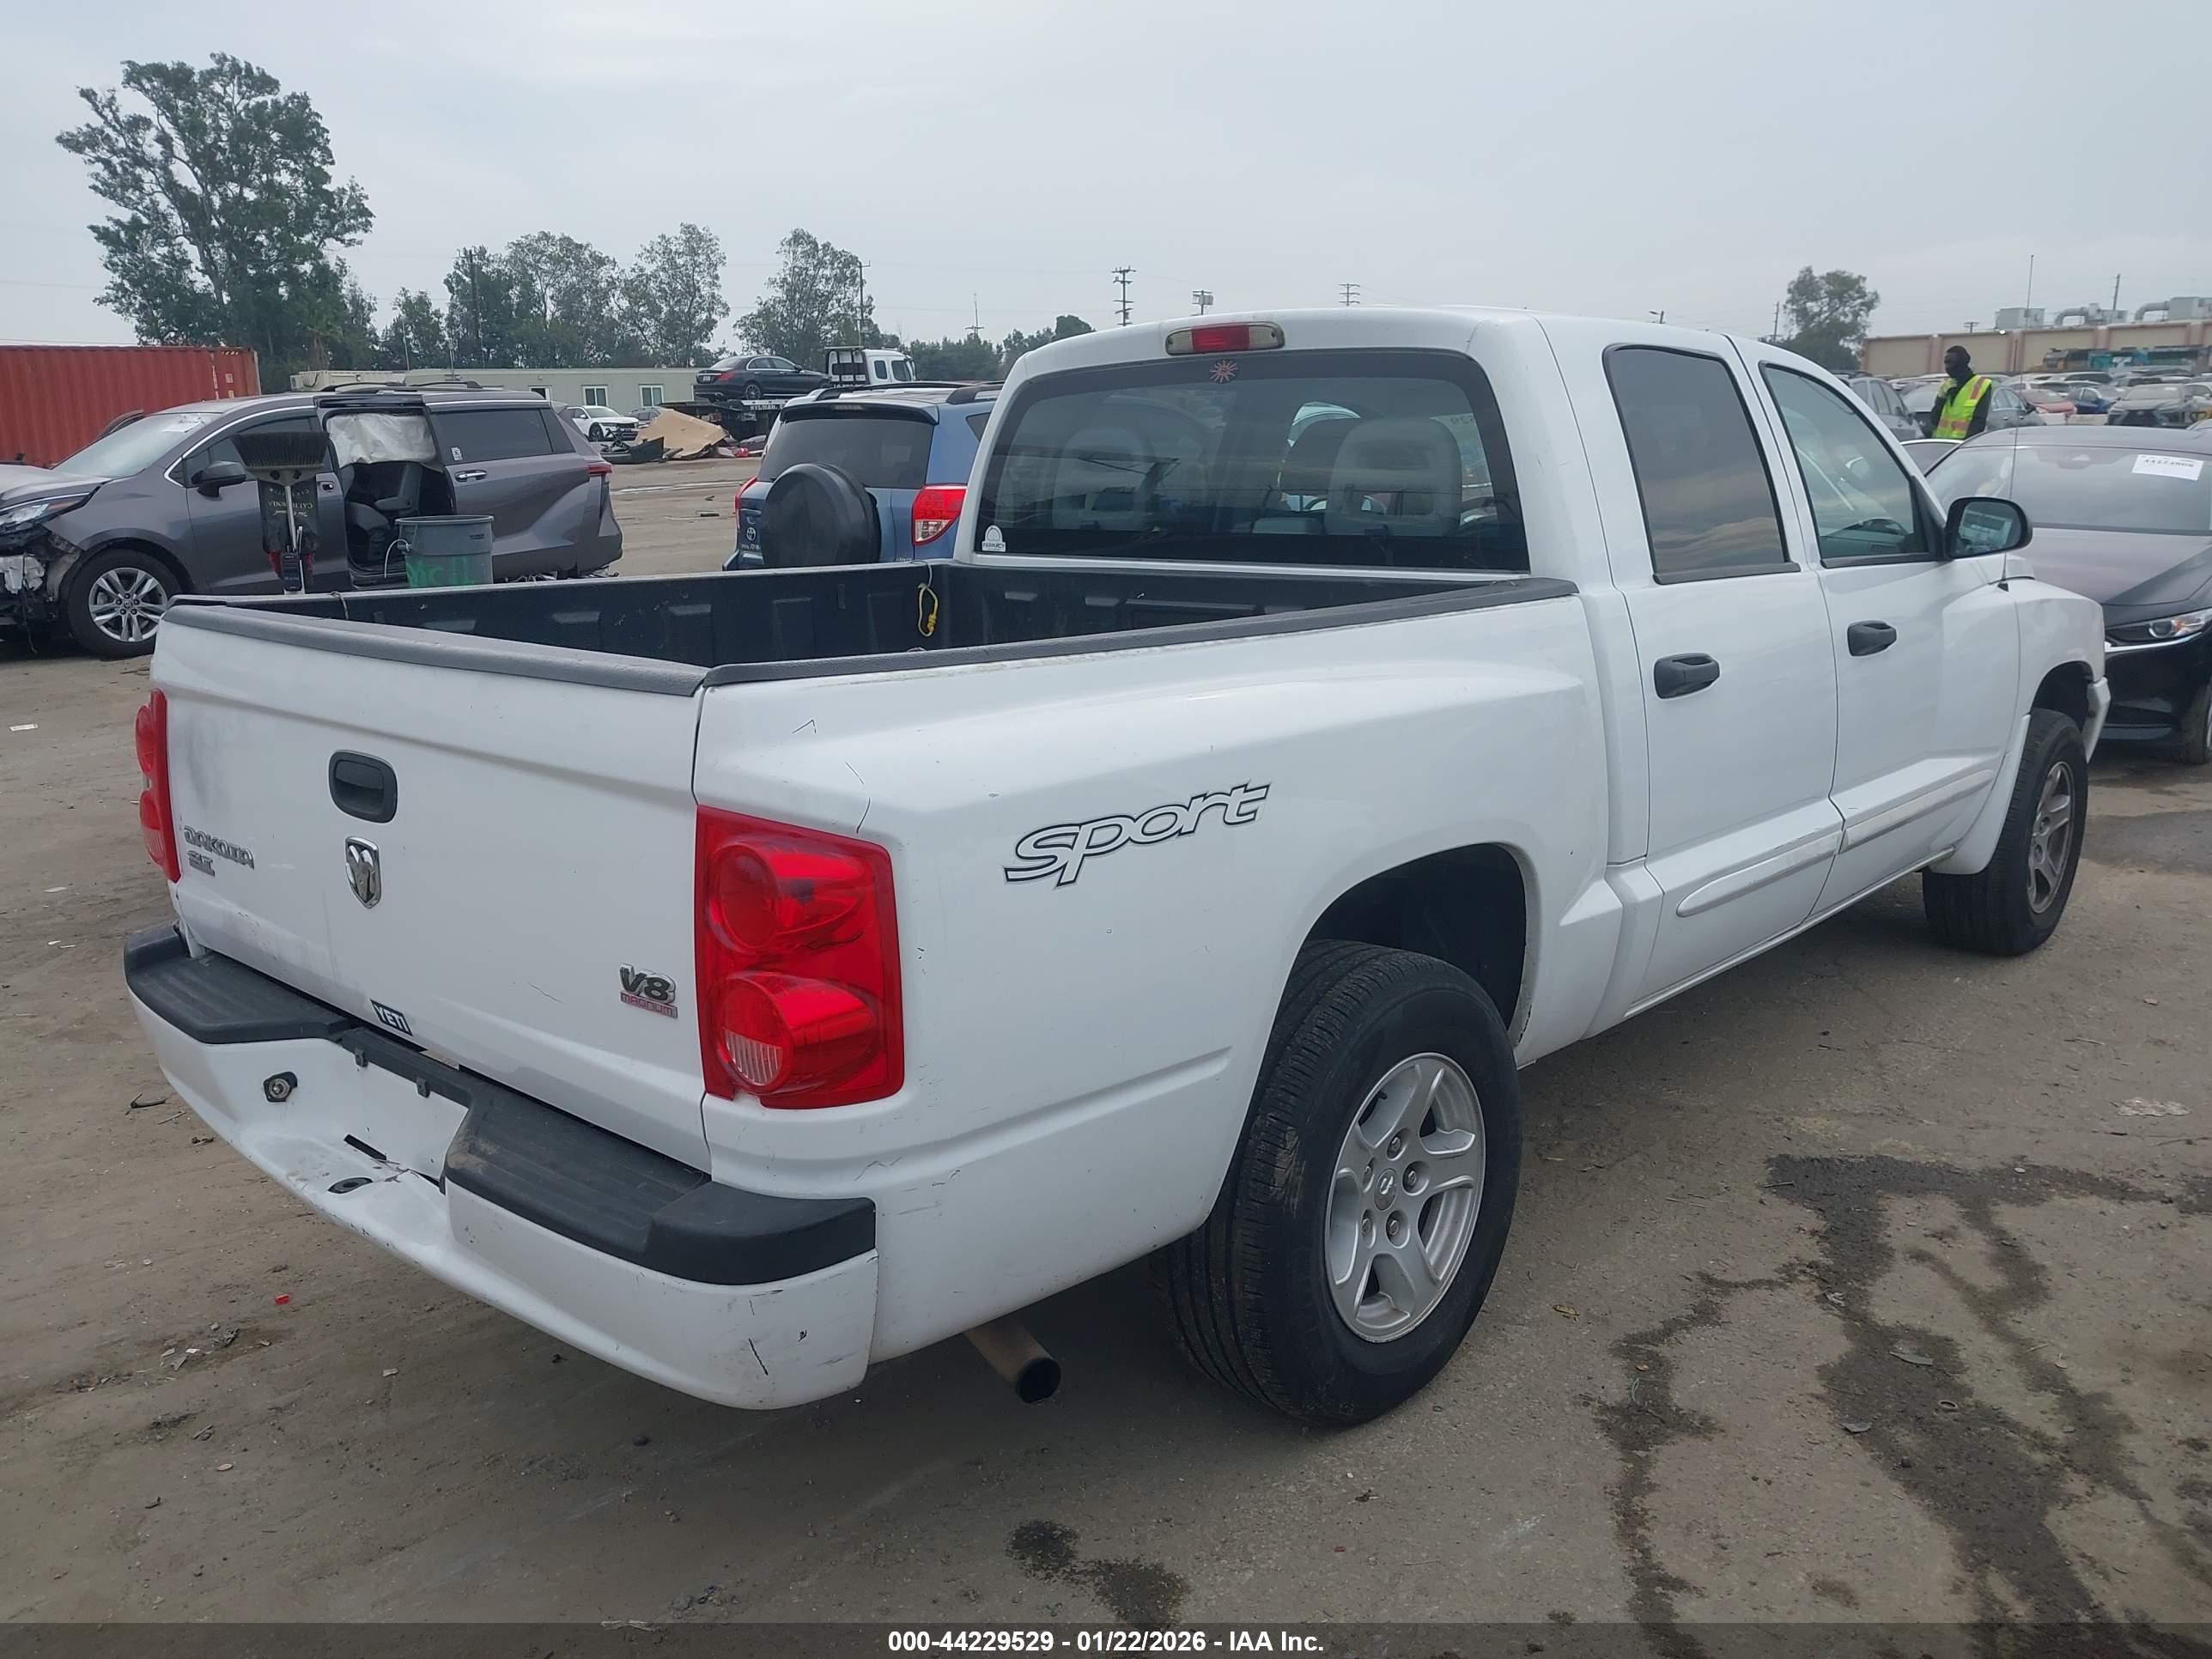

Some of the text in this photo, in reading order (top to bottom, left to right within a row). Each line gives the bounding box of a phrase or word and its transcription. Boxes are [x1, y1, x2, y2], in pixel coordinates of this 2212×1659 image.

[184, 825, 255, 869] DAKOTA
[619, 963, 677, 1004] V8
[373, 1003, 410, 1033] YETI
